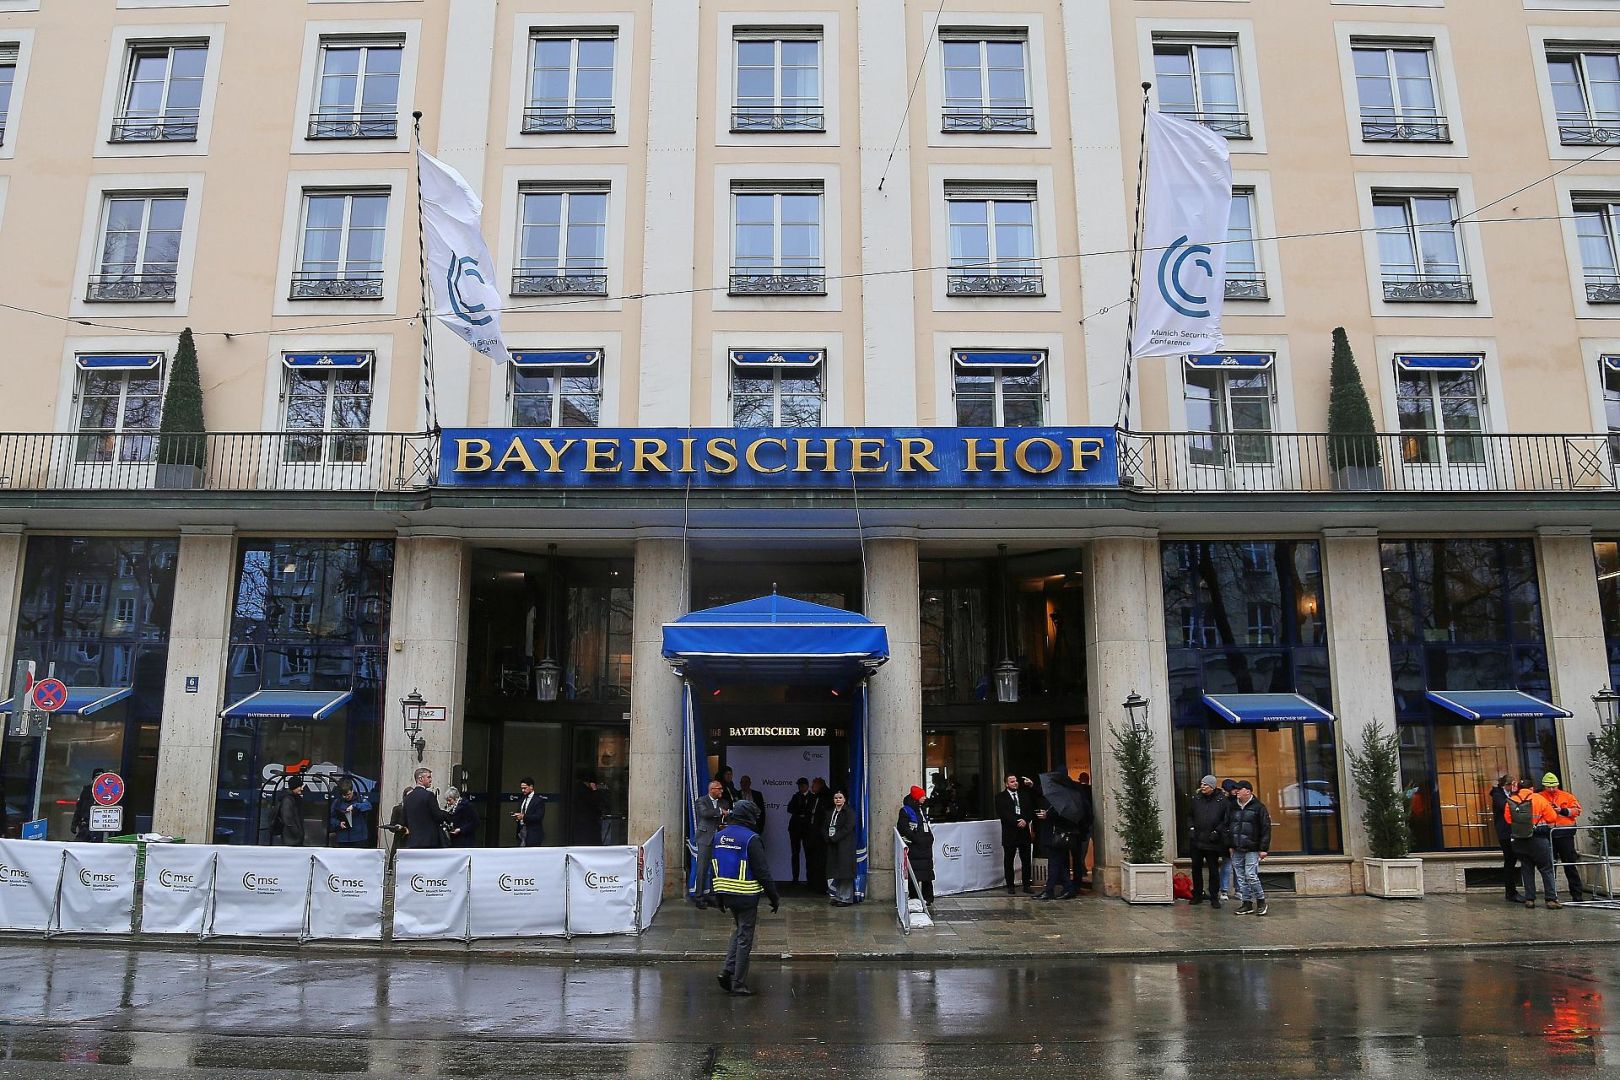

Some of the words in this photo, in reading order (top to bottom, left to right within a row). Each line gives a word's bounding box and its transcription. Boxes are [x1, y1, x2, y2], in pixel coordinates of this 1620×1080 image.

[1151, 329, 1179, 337] Munich
[1149, 337, 1191, 346] Conference
[453, 436, 941, 474] BAYERISCHER
[961, 437, 1105, 474] HOF
[189, 677, 195, 686] 6
[729, 727, 801, 737] BAYERISCHER
[806, 727, 827, 737] HOF
[10, 869, 30, 878] msc
[93, 874, 116, 882] msc
[173, 874, 194, 883] msc
[257, 877, 279, 885] msc
[426, 879, 448, 887] msc
[514, 878, 535, 886] msc
[599, 875, 619, 883] msc
[342, 879, 364, 888] msc
